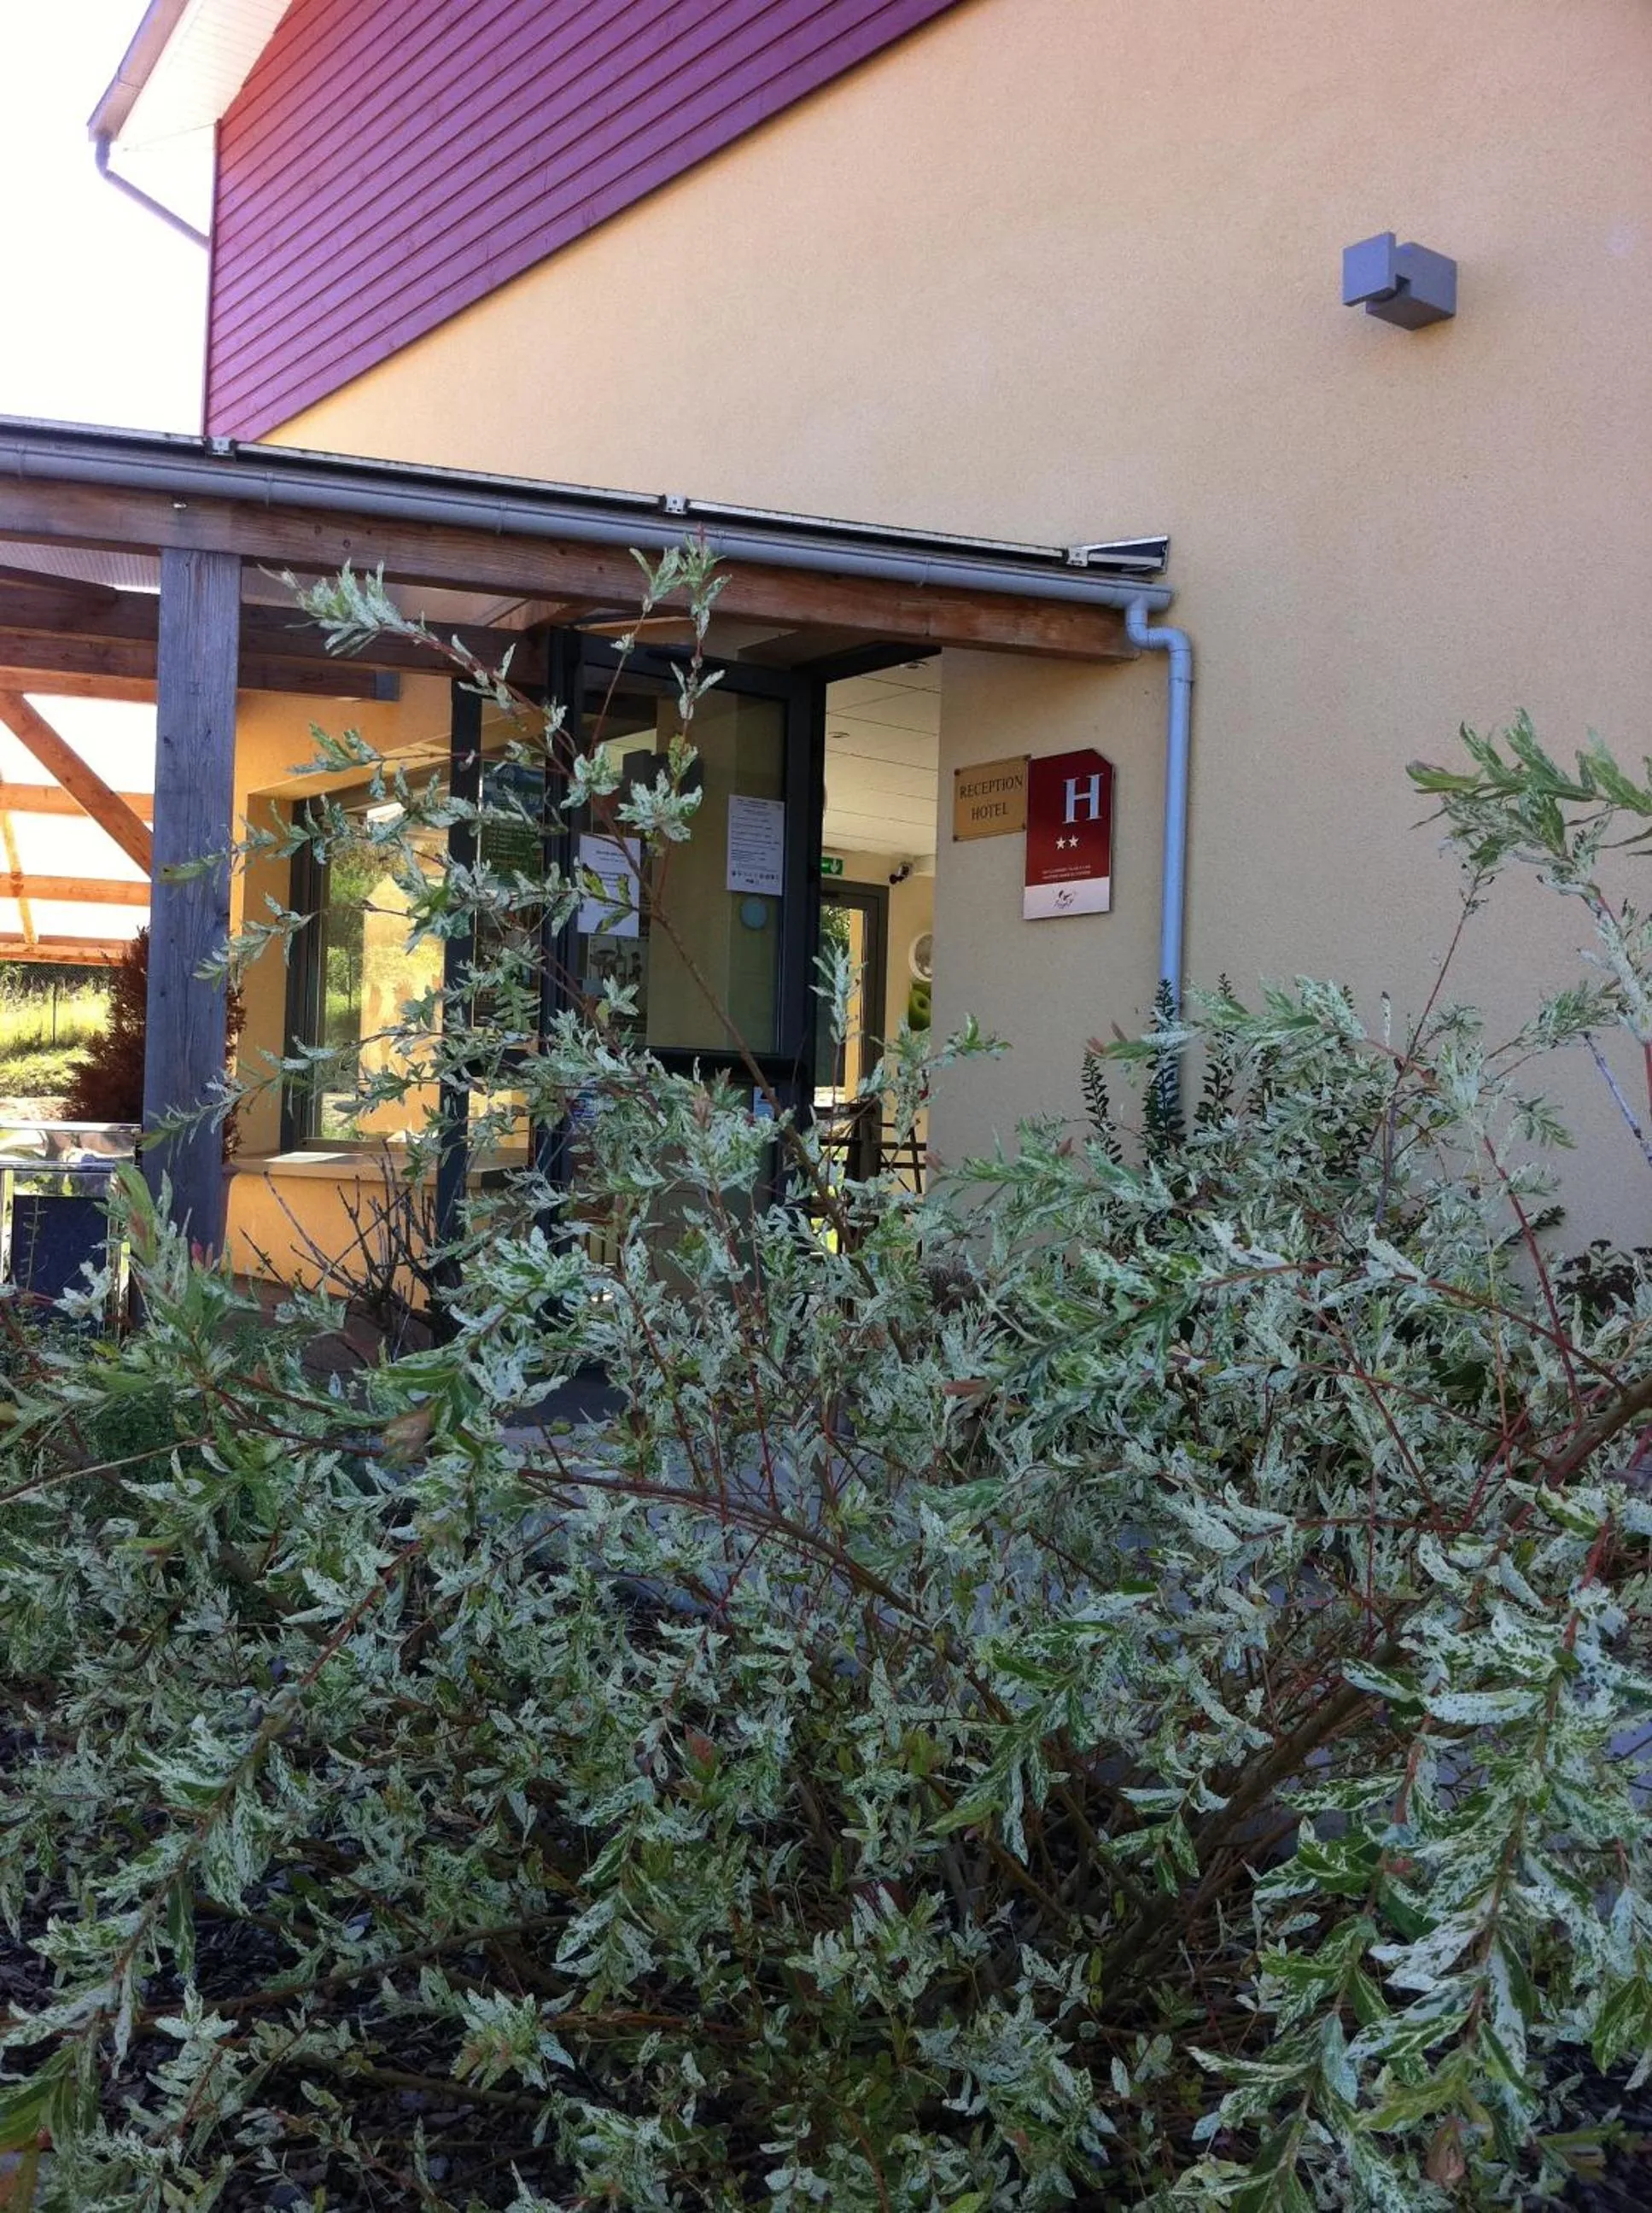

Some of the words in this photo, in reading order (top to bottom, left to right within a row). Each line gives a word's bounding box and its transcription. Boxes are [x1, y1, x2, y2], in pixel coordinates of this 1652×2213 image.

[960, 775, 1023, 799] RECEPTION
[1062, 773, 1104, 824] H
[971, 803, 1008, 820] HOTEL
